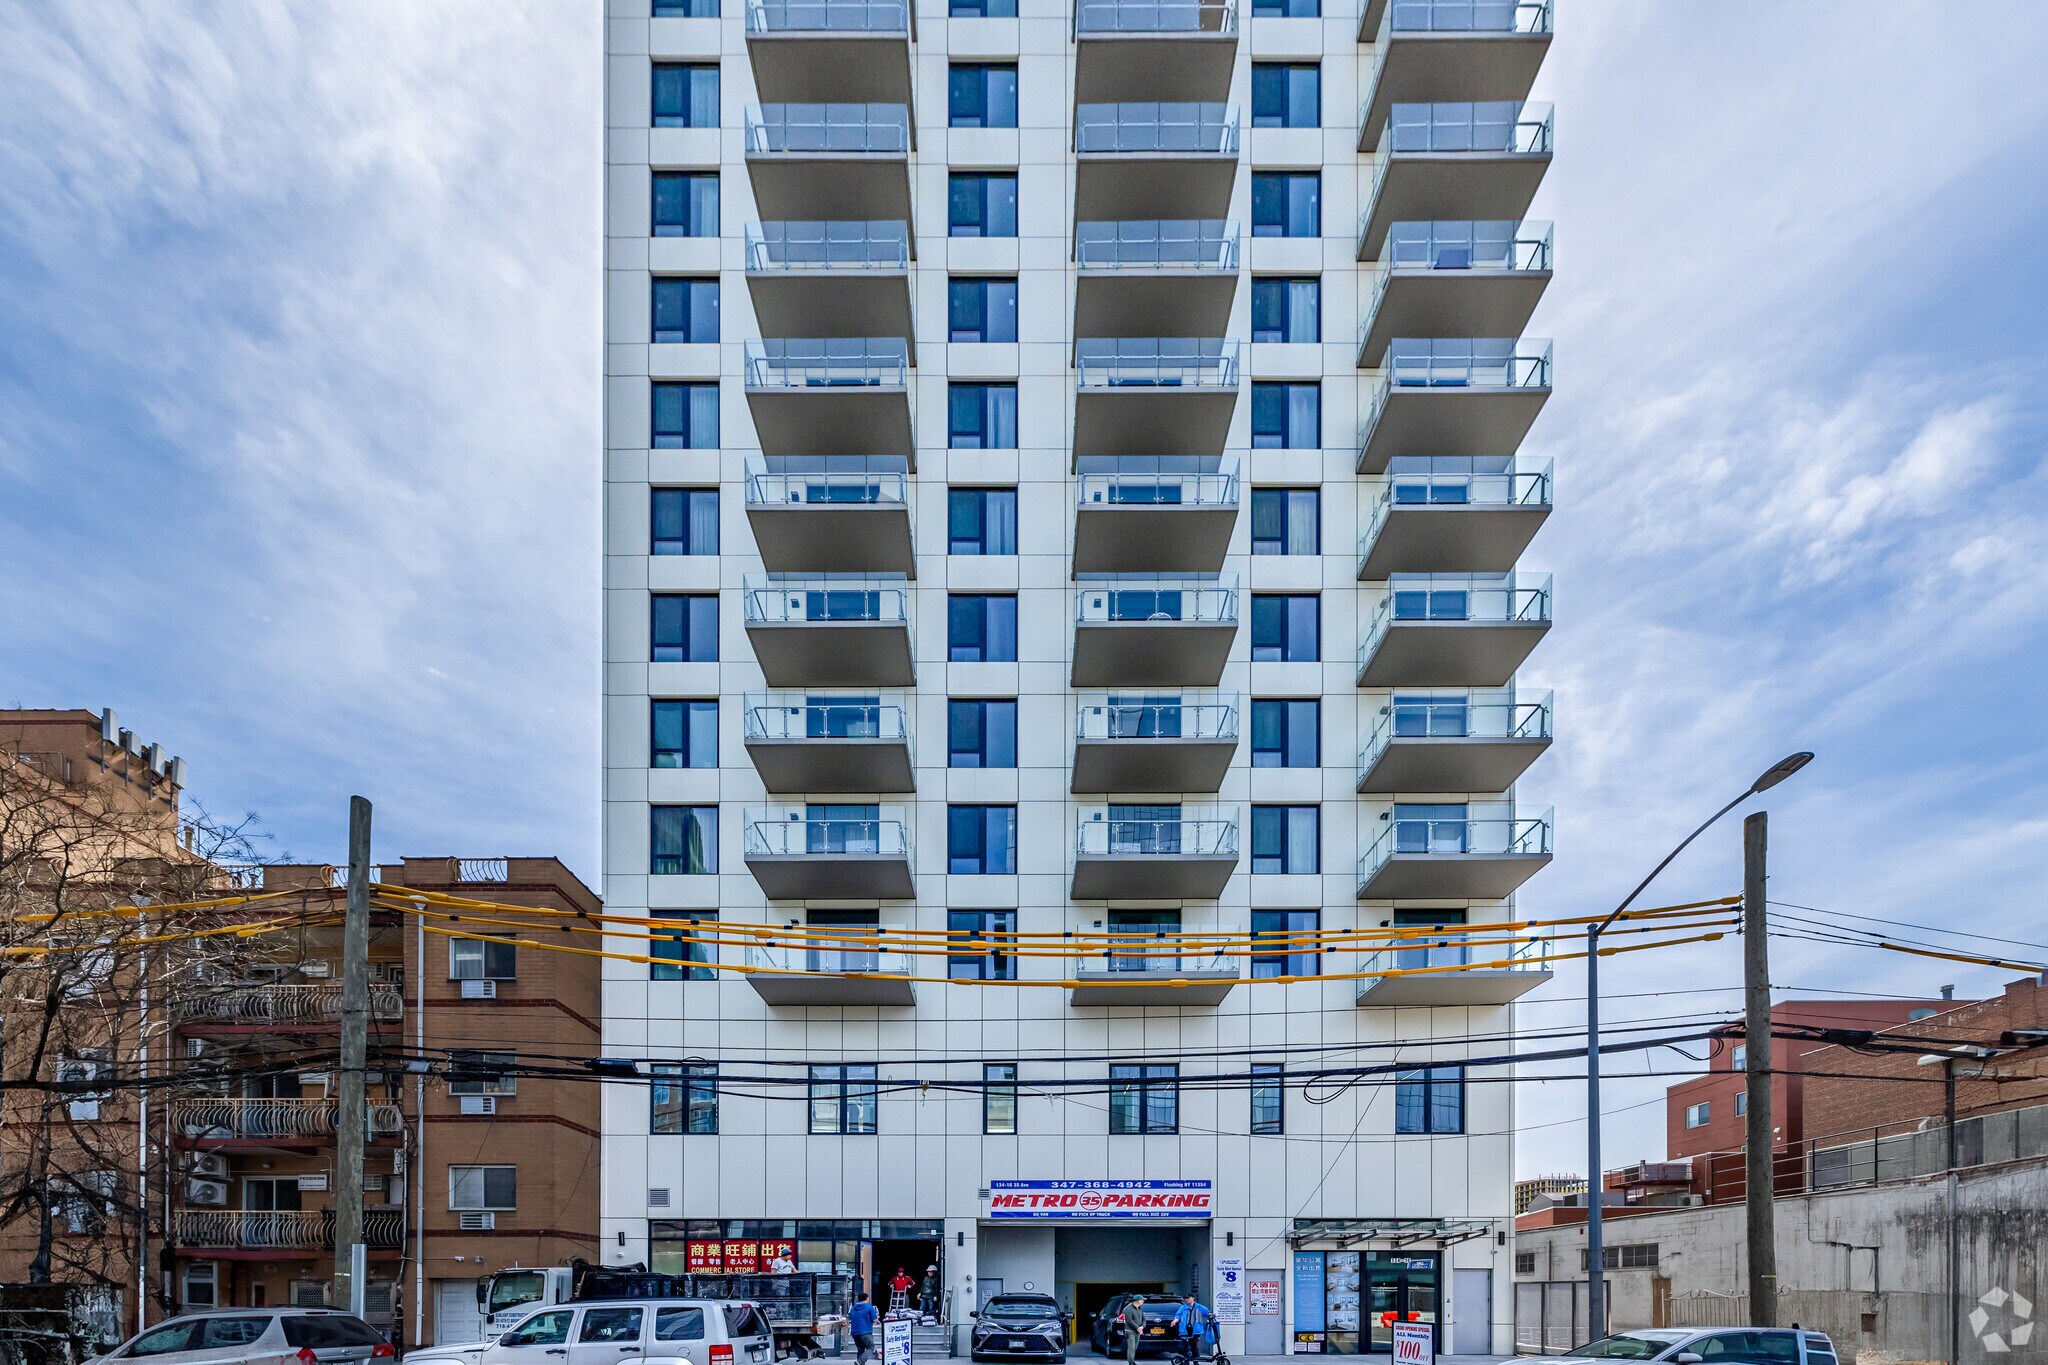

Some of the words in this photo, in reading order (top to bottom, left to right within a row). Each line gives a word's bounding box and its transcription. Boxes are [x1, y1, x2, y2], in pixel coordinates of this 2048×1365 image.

[992, 1194, 1078, 1207] METRO
[1081, 1196, 1101, 1206] 35
[1102, 1194, 1210, 1207] PARKING
[1407, 1332, 1430, 1340] Monthly
[1395, 1339, 1421, 1360] $100
[1418, 1354, 1430, 1362] OFF
